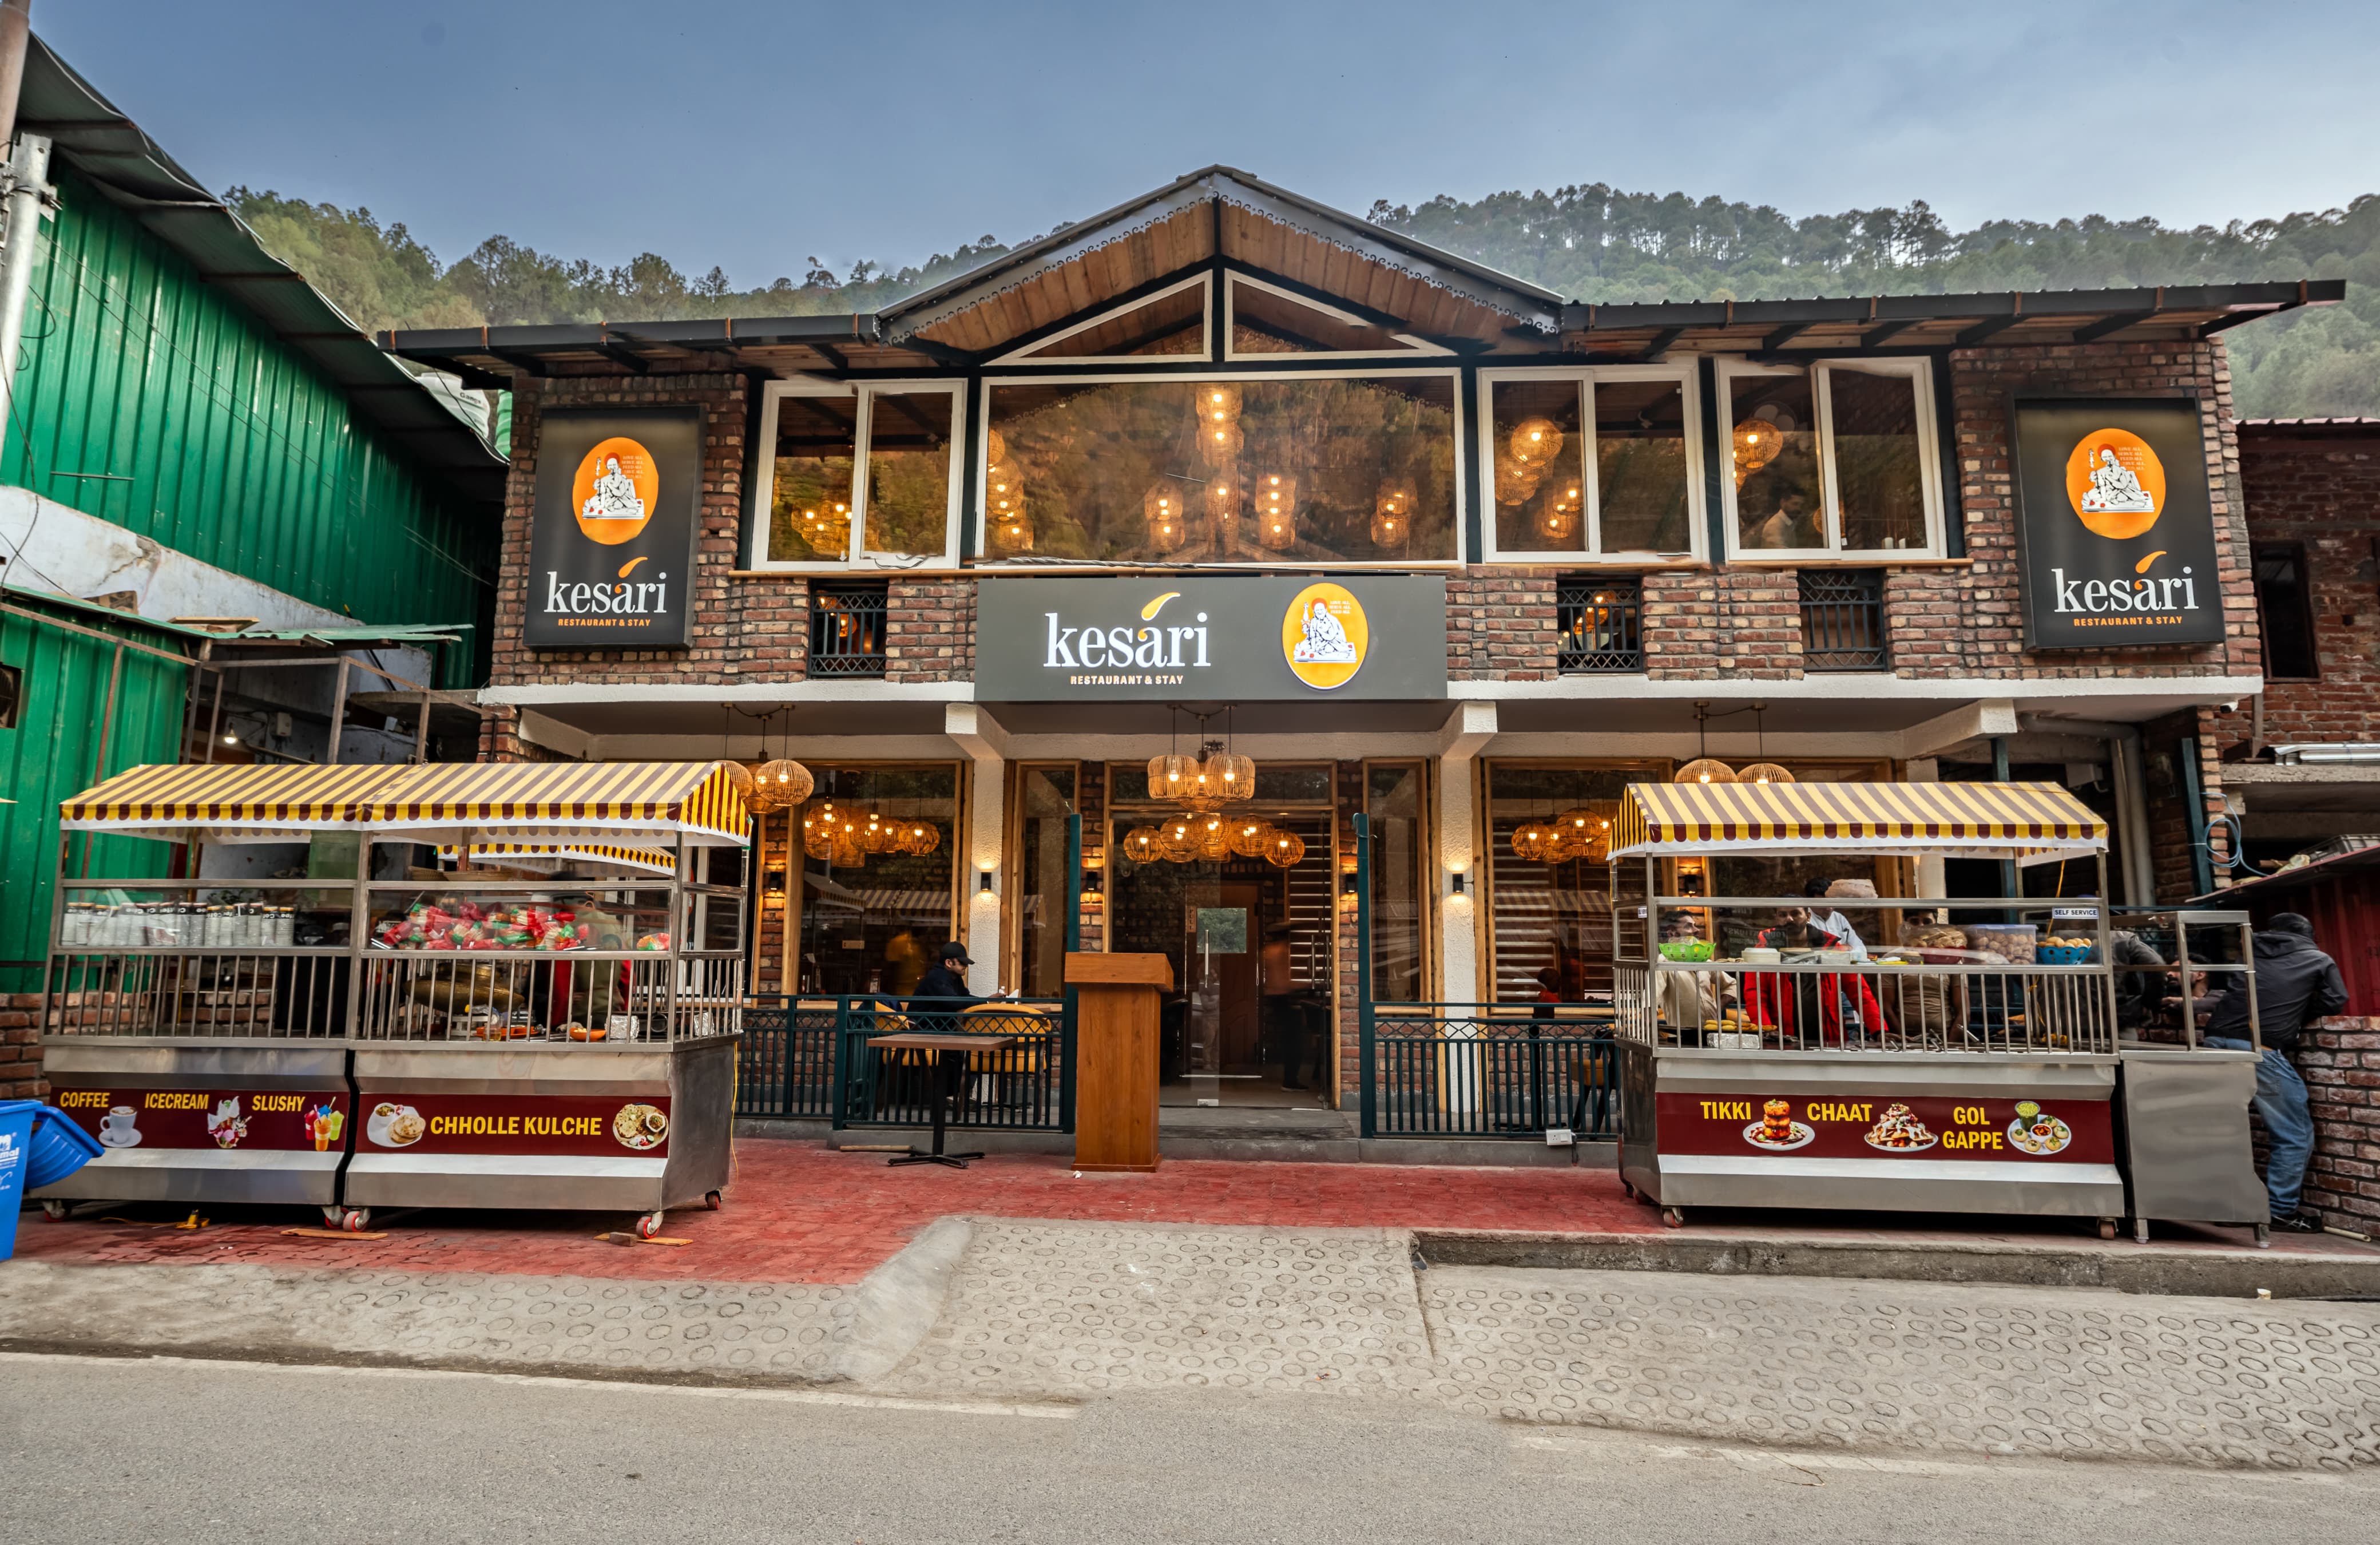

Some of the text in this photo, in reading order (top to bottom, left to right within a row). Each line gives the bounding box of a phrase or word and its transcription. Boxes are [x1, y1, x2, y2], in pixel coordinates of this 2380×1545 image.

[544, 557, 667, 613] kesari
[2051, 551, 2199, 612] kesari
[558, 619, 617, 627] RESTAURANT
[1043, 592, 1211, 668] kesari
[2074, 616, 2183, 627] RESTAURANT & STAY
[1070, 675, 1183, 685] RESTAURANT & STAY
[60, 1092, 110, 1108] COFFEE
[145, 1092, 209, 1110] ICECREAM
[252, 1095, 306, 1112] SLUSHY
[1700, 1102, 1751, 1119] TIKKI
[1807, 1103, 1873, 1122] CHAAT
[1953, 1106, 1990, 1125] GOL
[430, 1116, 602, 1135] CHHOLLE KULCHE
[1942, 1131, 2003, 1150] GAPPE
